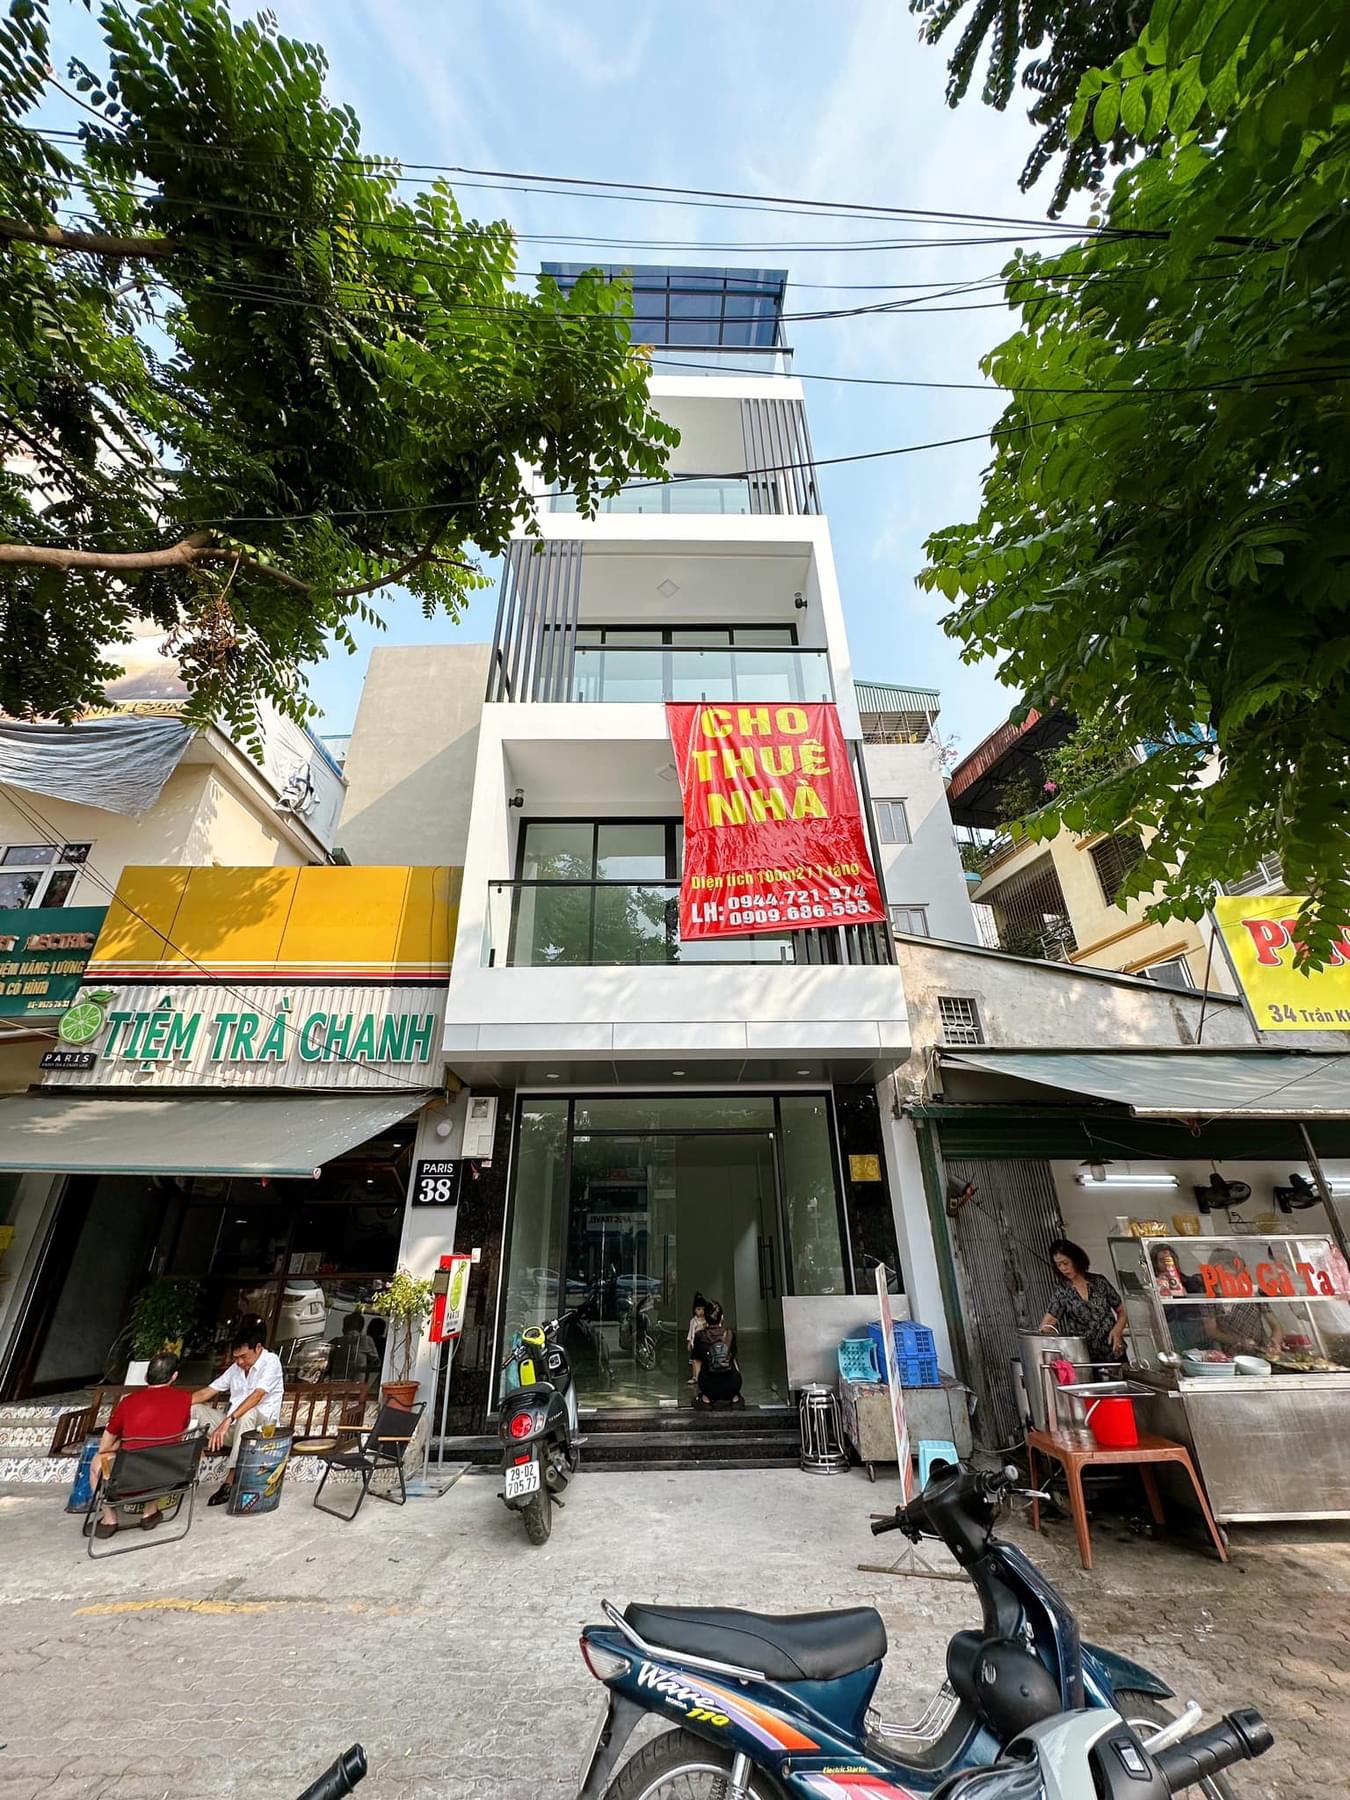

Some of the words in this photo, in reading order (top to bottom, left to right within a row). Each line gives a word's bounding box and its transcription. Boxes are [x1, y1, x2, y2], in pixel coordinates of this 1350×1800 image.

[701, 707, 809, 738] CHO
[692, 738, 831, 783] THUÊ
[707, 779, 829, 827] NHÀ
[691, 876, 724, 891] Diện
[691, 901, 725, 923] LH:
[728, 884, 867, 910] 0944.721.974
[729, 900, 871, 926] 0909.686.555
[1268, 1004, 1297, 1022] 34
[101, 995, 202, 1073] TIỆM
[211, 996, 293, 1063] TRÀ
[299, 1010, 435, 1063] CHANH
[45, 1054, 90, 1063] PARIS
[423, 1163, 454, 1173] PARIS
[419, 1179, 451, 1202] 38
[1199, 1256, 1253, 1297] Phở
[1256, 1261, 1296, 1297] Gà
[1296, 1262, 1336, 1296] Ta
[637, 1661, 728, 1714] Wave
[686, 1707, 730, 1726] 110
